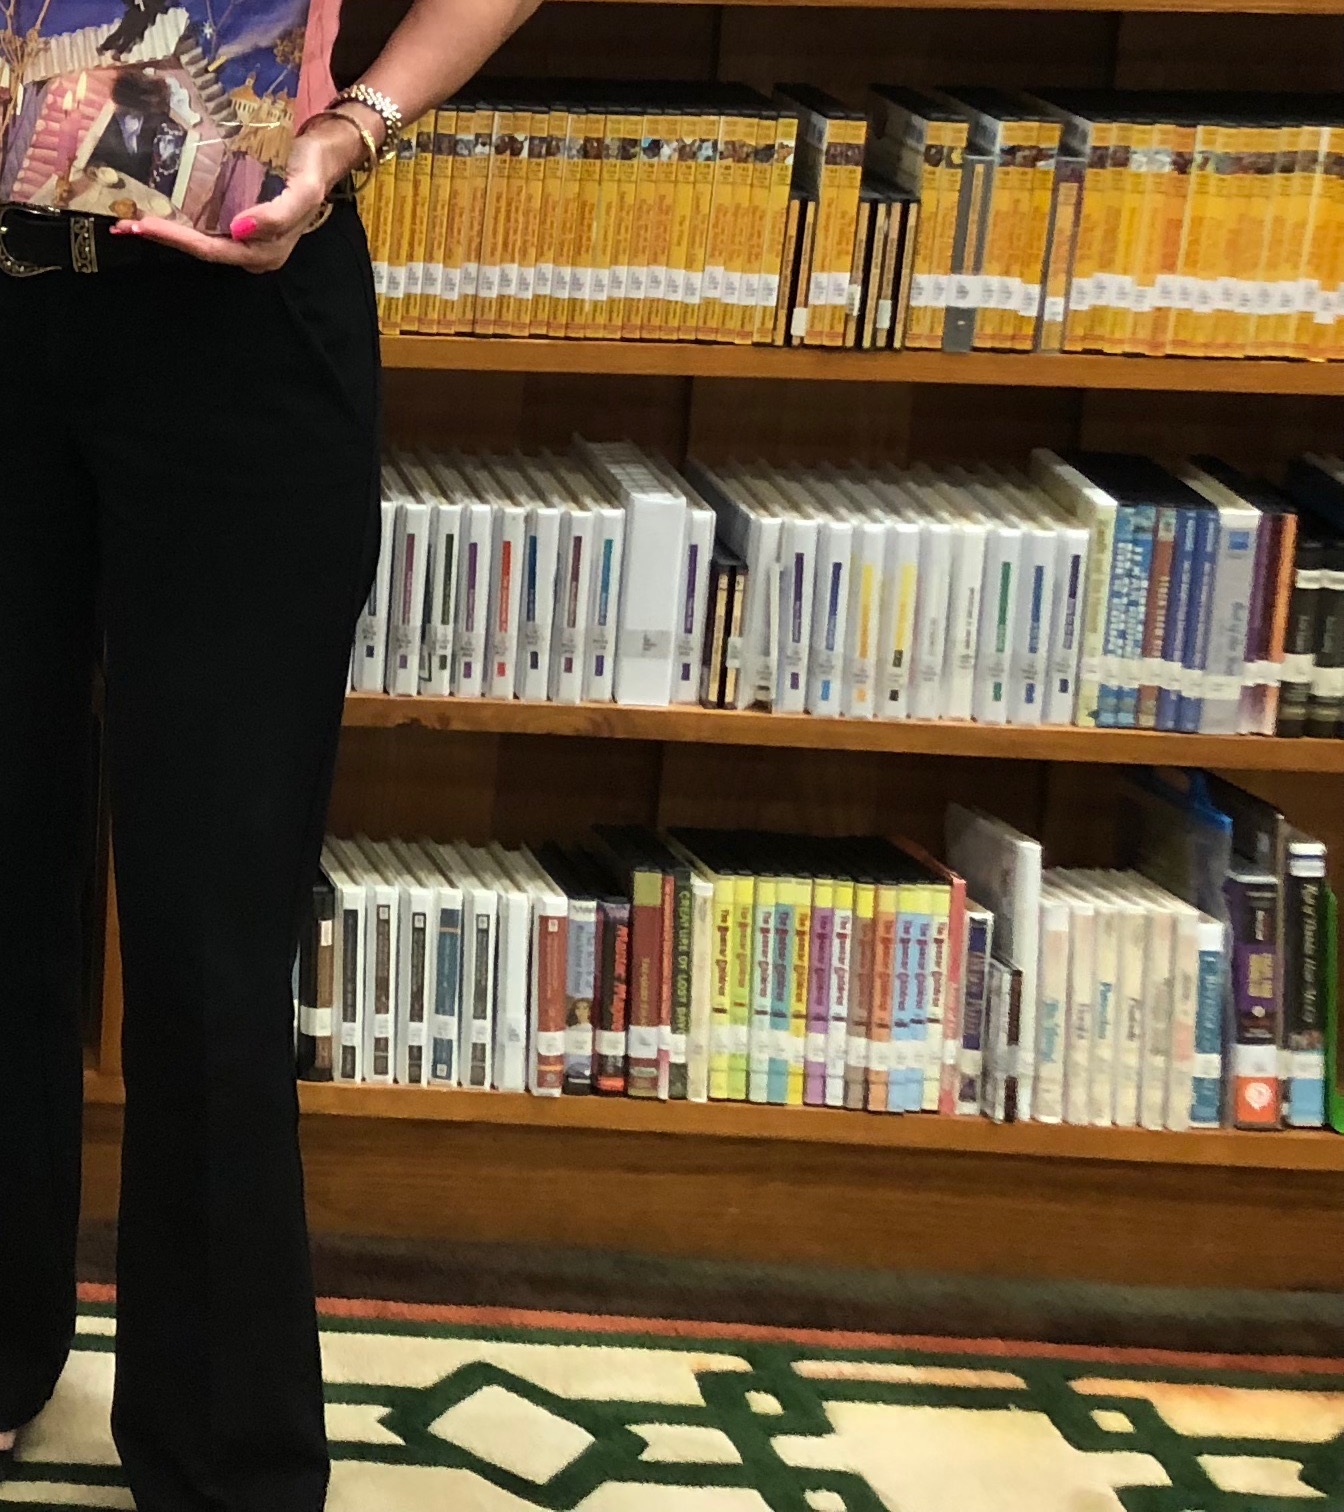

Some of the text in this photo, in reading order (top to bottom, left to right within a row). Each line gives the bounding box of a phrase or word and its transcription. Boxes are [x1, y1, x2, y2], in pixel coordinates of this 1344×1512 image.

[678, 891, 690, 952] CREATURE
[678, 956, 688, 969] OF
[677, 975, 688, 1003] LOST
